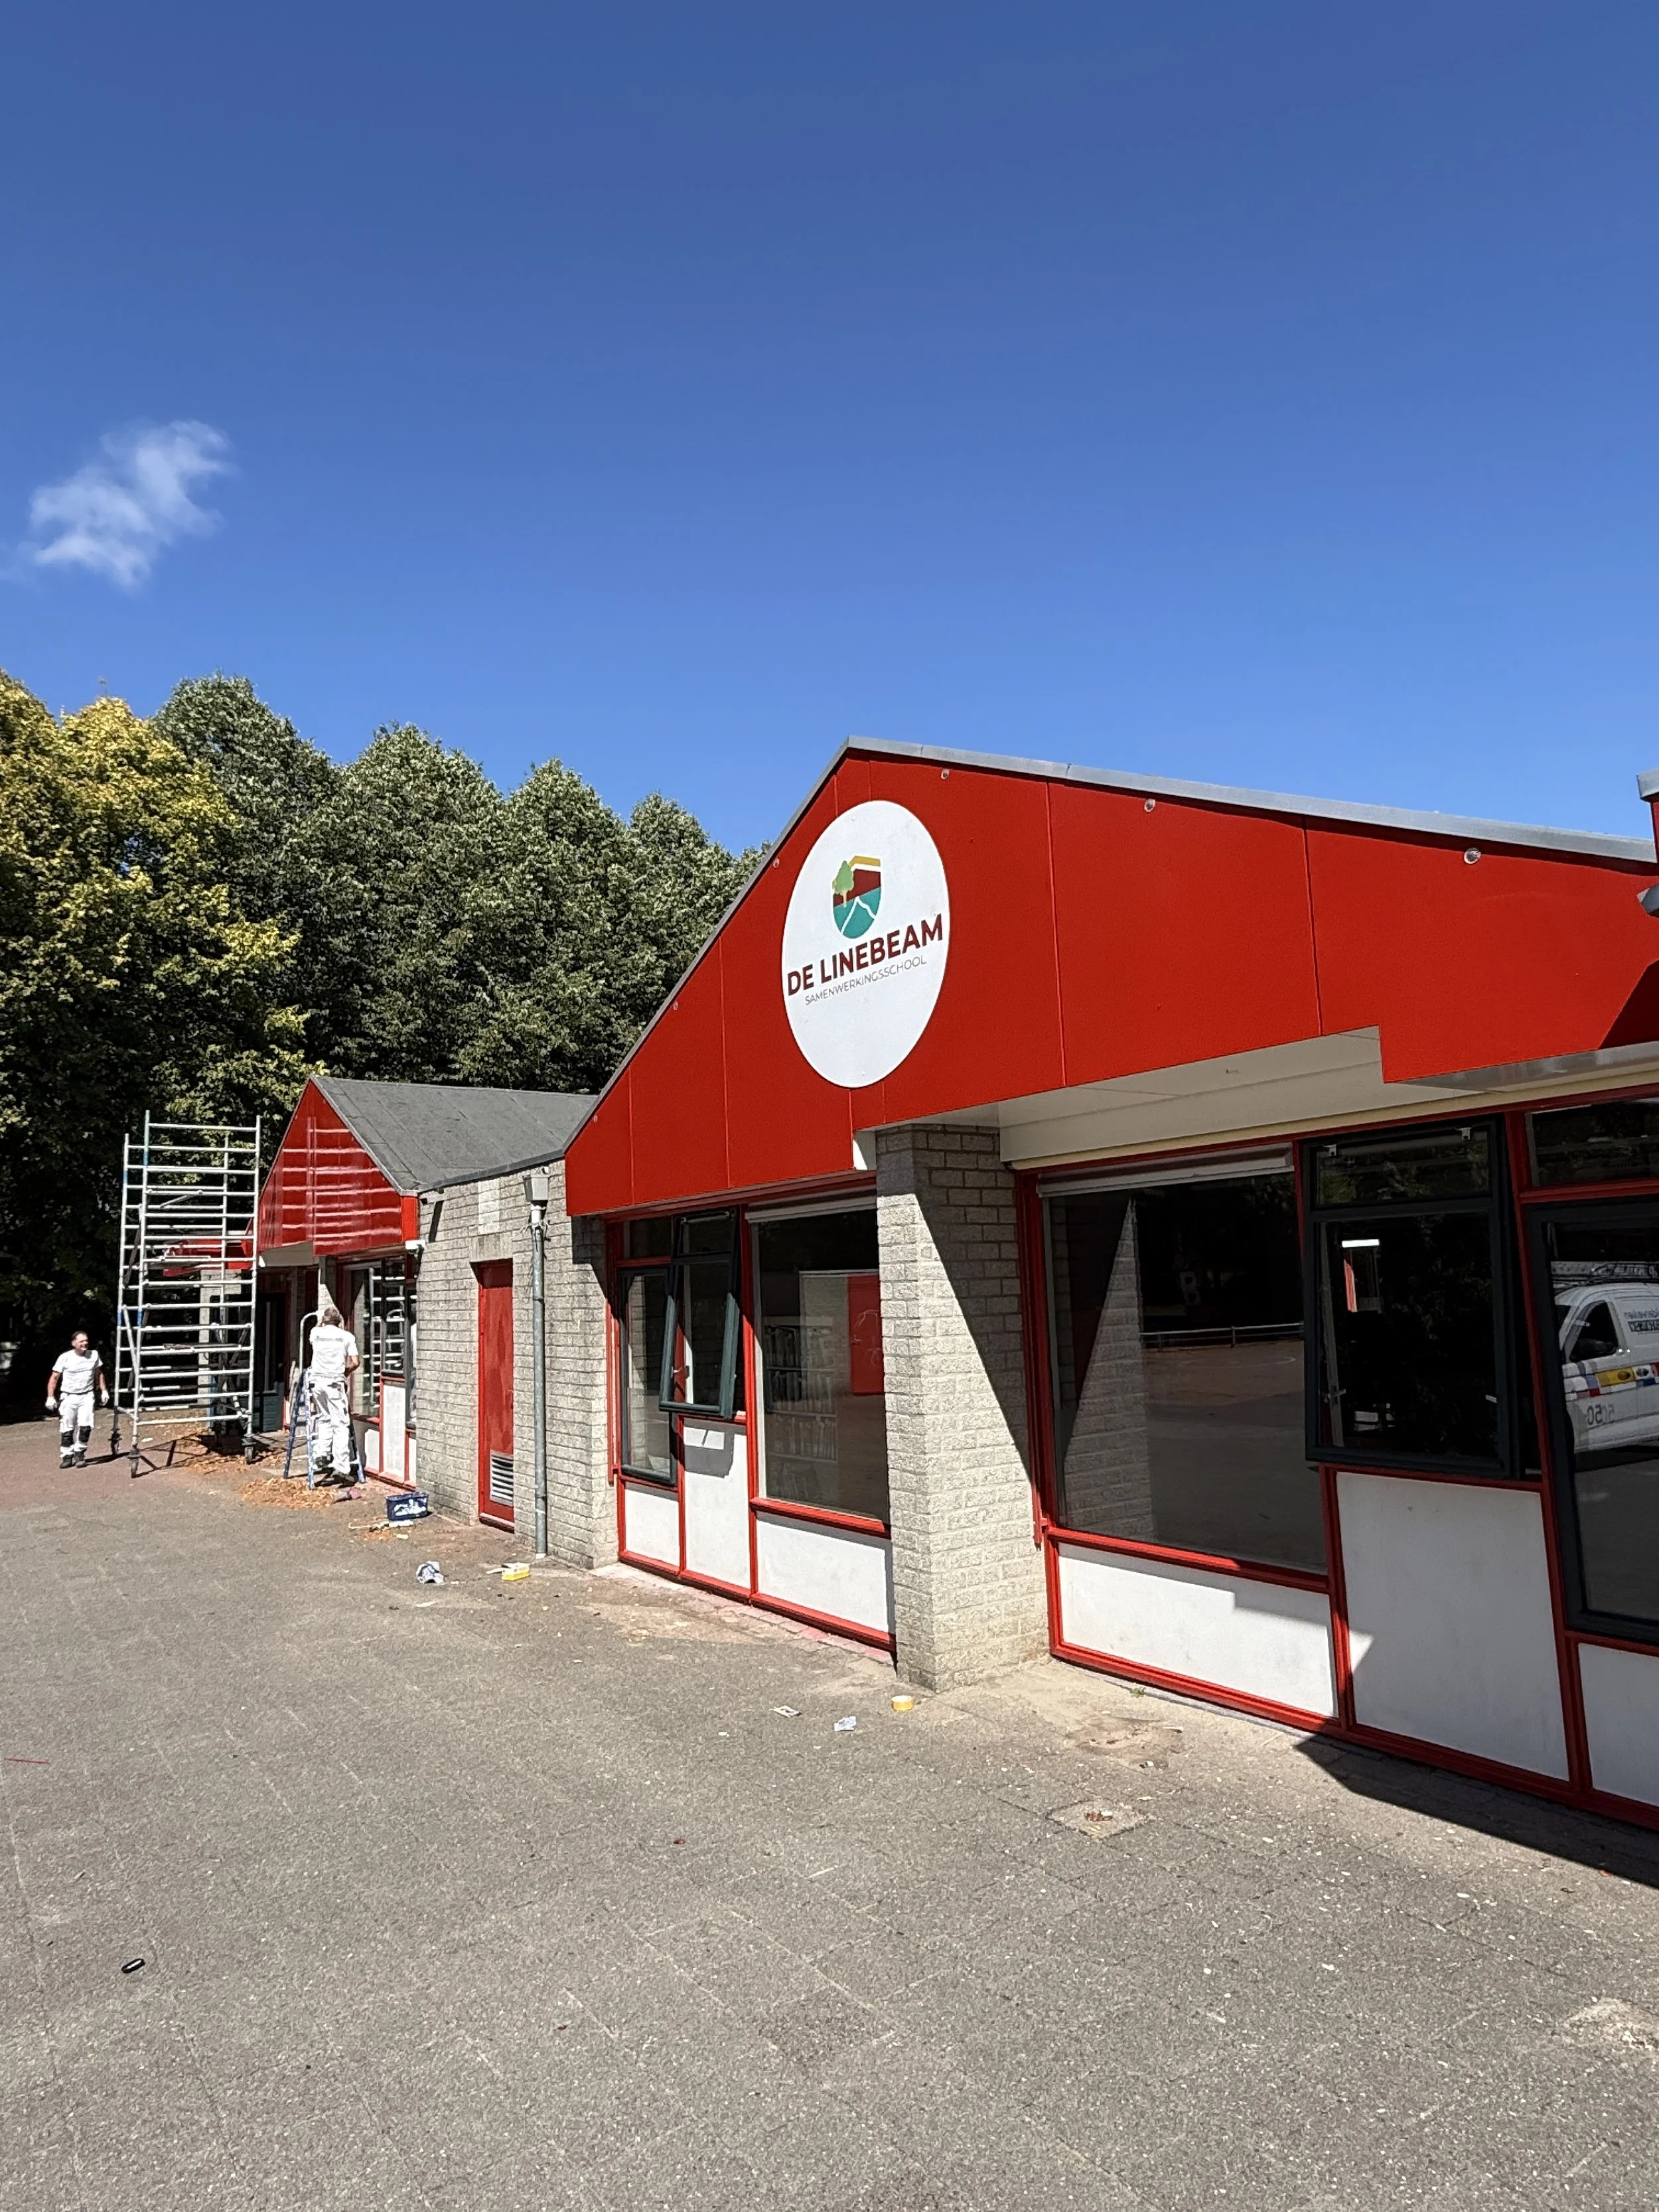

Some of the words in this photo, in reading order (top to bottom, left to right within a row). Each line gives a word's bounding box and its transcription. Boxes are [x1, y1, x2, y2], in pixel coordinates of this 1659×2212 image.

[787, 964, 814, 996] DE
[820, 913, 943, 984] LINEBEAM
[805, 955, 926, 1005] SAMENWERKINGSSCHOOL
